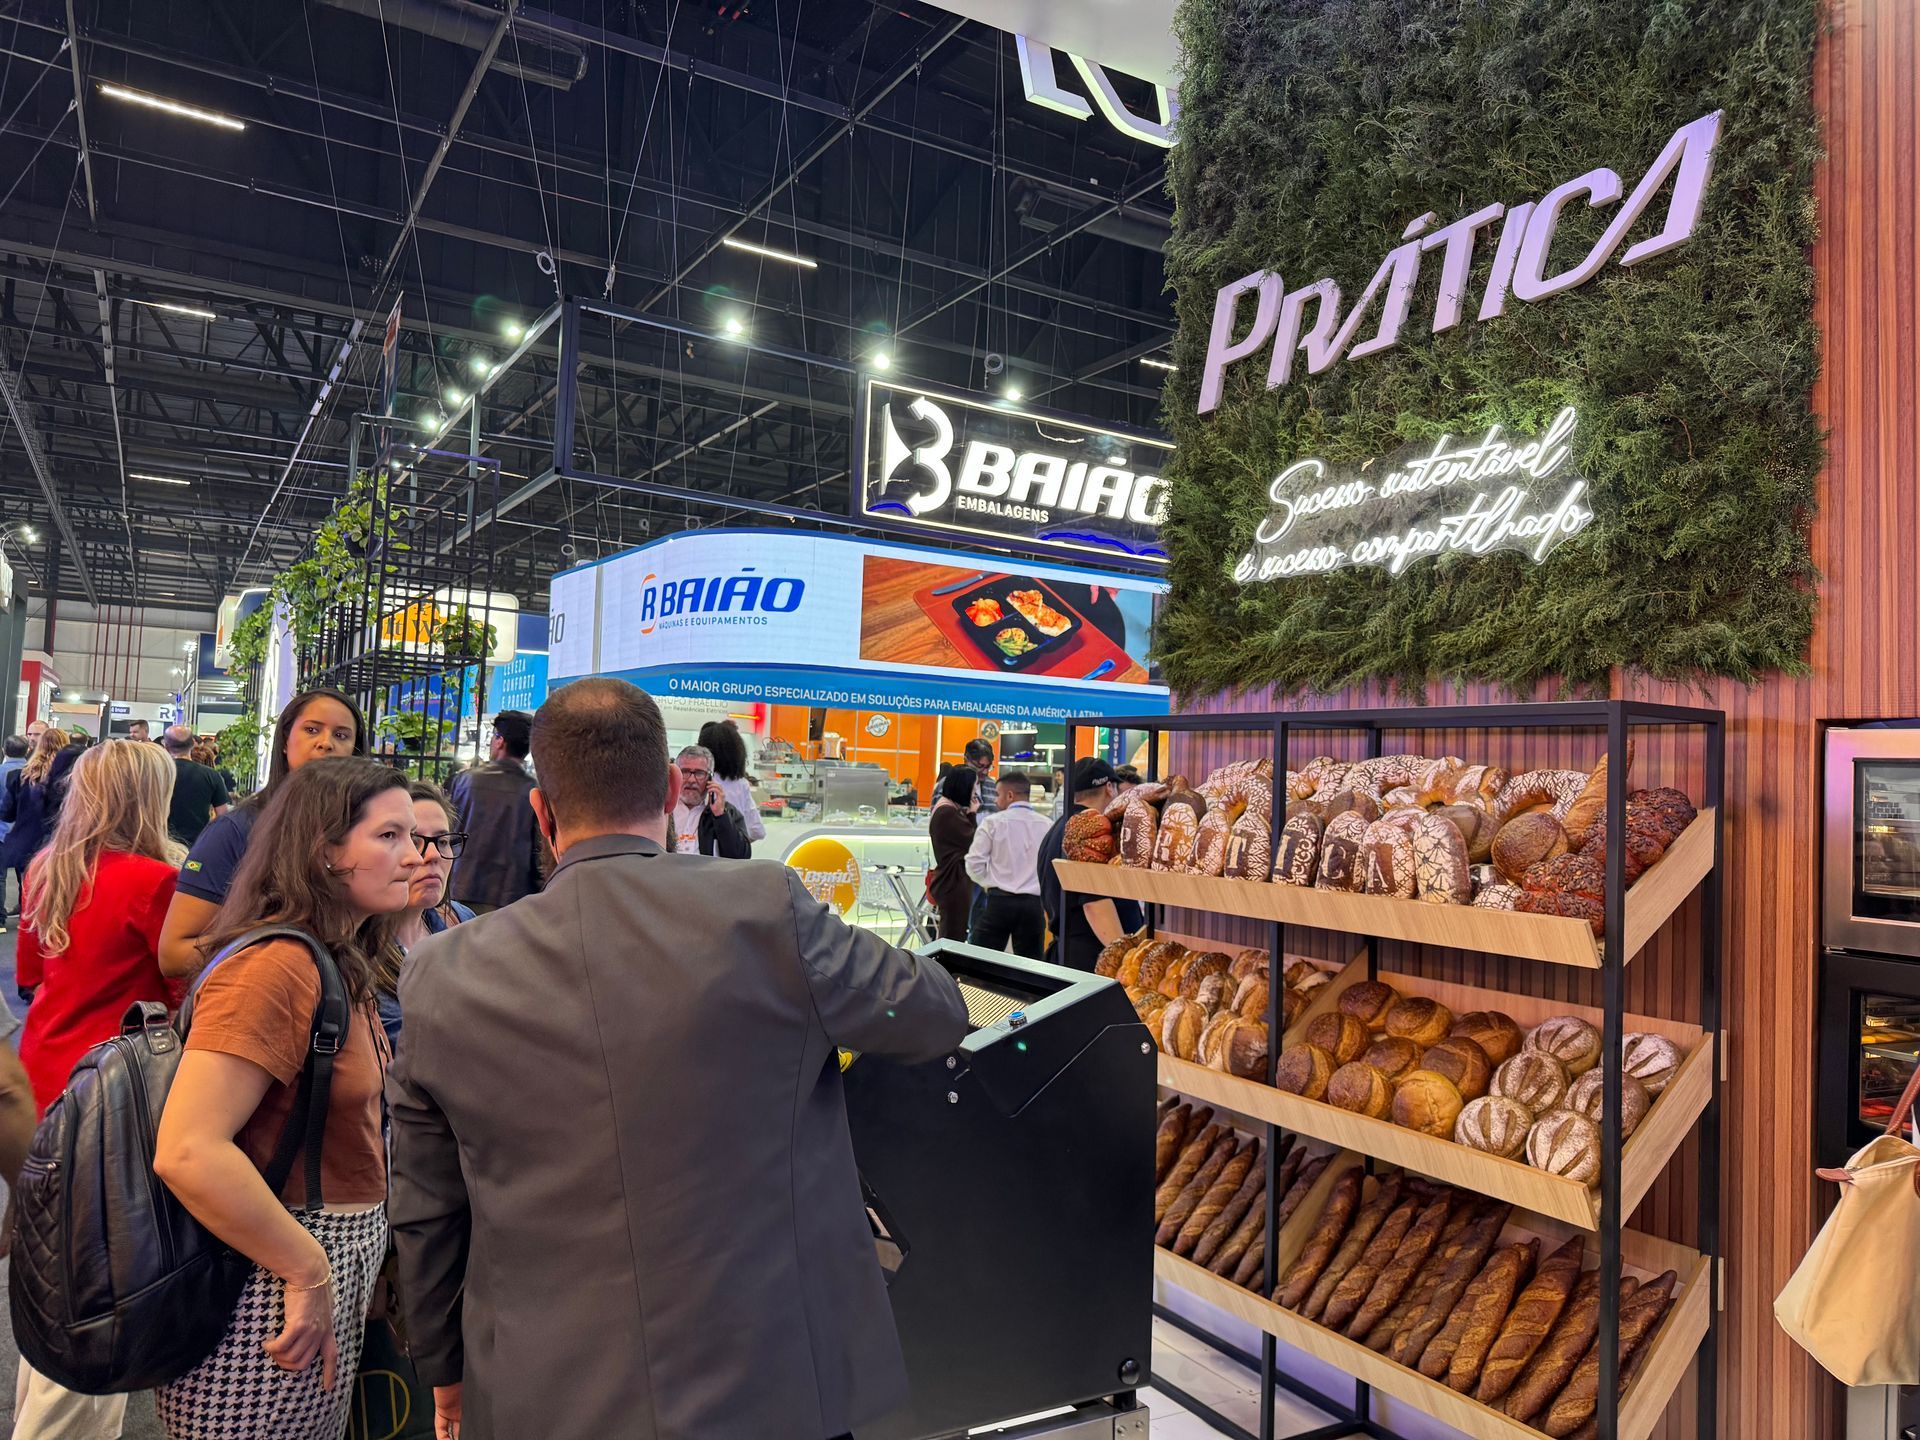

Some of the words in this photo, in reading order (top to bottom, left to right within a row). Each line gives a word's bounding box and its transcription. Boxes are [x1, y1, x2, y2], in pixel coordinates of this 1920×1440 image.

[1198, 108, 1726, 415] PRÁTICA
[956, 440, 1172, 527] BAIÃO
[956, 495, 1050, 524] EMBALAGENS
[1255, 459, 1376, 544] Sucesso
[1380, 406, 1578, 497] sustentável
[1258, 545, 1348, 580] sucesso
[1351, 479, 1594, 575] compartilhado
[659, 567, 806, 618] BAIÃO
[690, 615, 768, 627] EQUIPAMENTOS
[668, 678, 679, 690] O
[680, 679, 720, 694] MAIOR
[721, 682, 763, 696] GRUPO
[764, 685, 849, 704] ESPECIALIZADO
[850, 692, 867, 705] EM
[867, 692, 922, 710] SOLUÇÕES
[923, 698, 950, 711] PARA
[951, 700, 1016, 716] EMBALAGENS
[1017, 705, 1030, 717] DA
[1031, 703, 1073, 719] AMÉRICA
